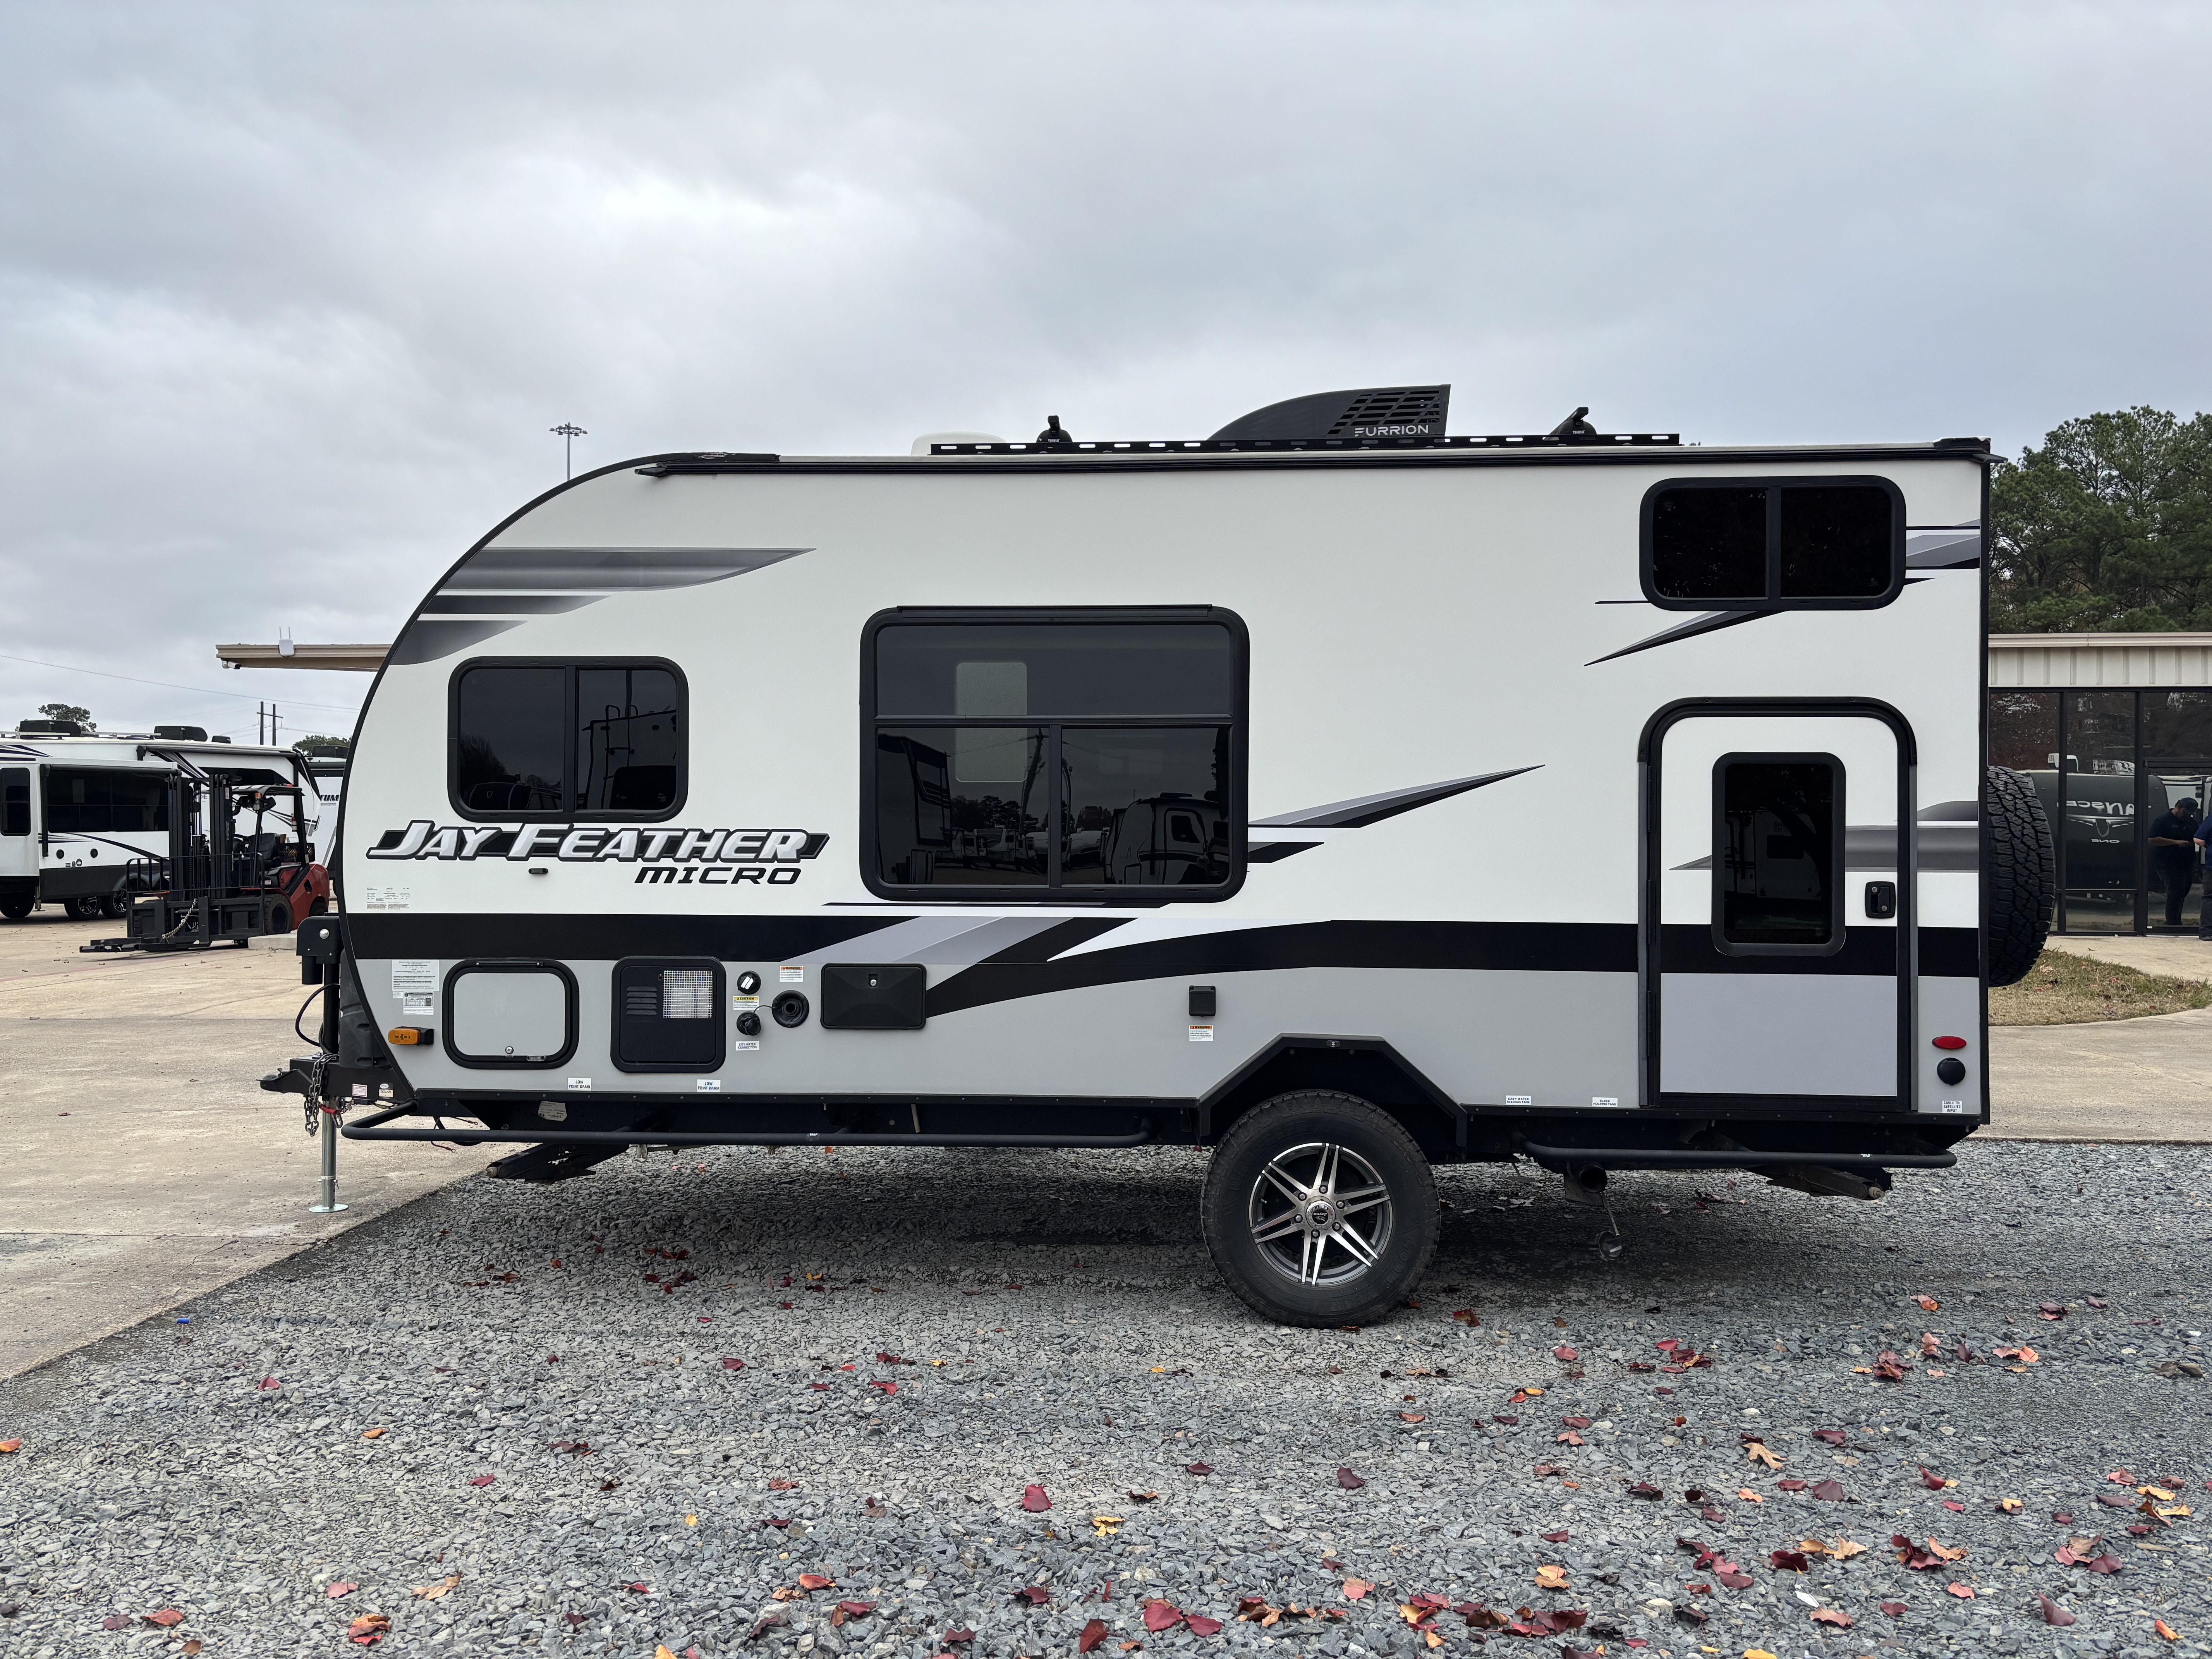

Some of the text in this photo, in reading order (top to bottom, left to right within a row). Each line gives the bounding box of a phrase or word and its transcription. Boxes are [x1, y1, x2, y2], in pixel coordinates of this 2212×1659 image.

[1355, 425, 1429, 437] FURRION
[366, 820, 811, 863] JAY FEATHER
[634, 867, 802, 885] MICRO
